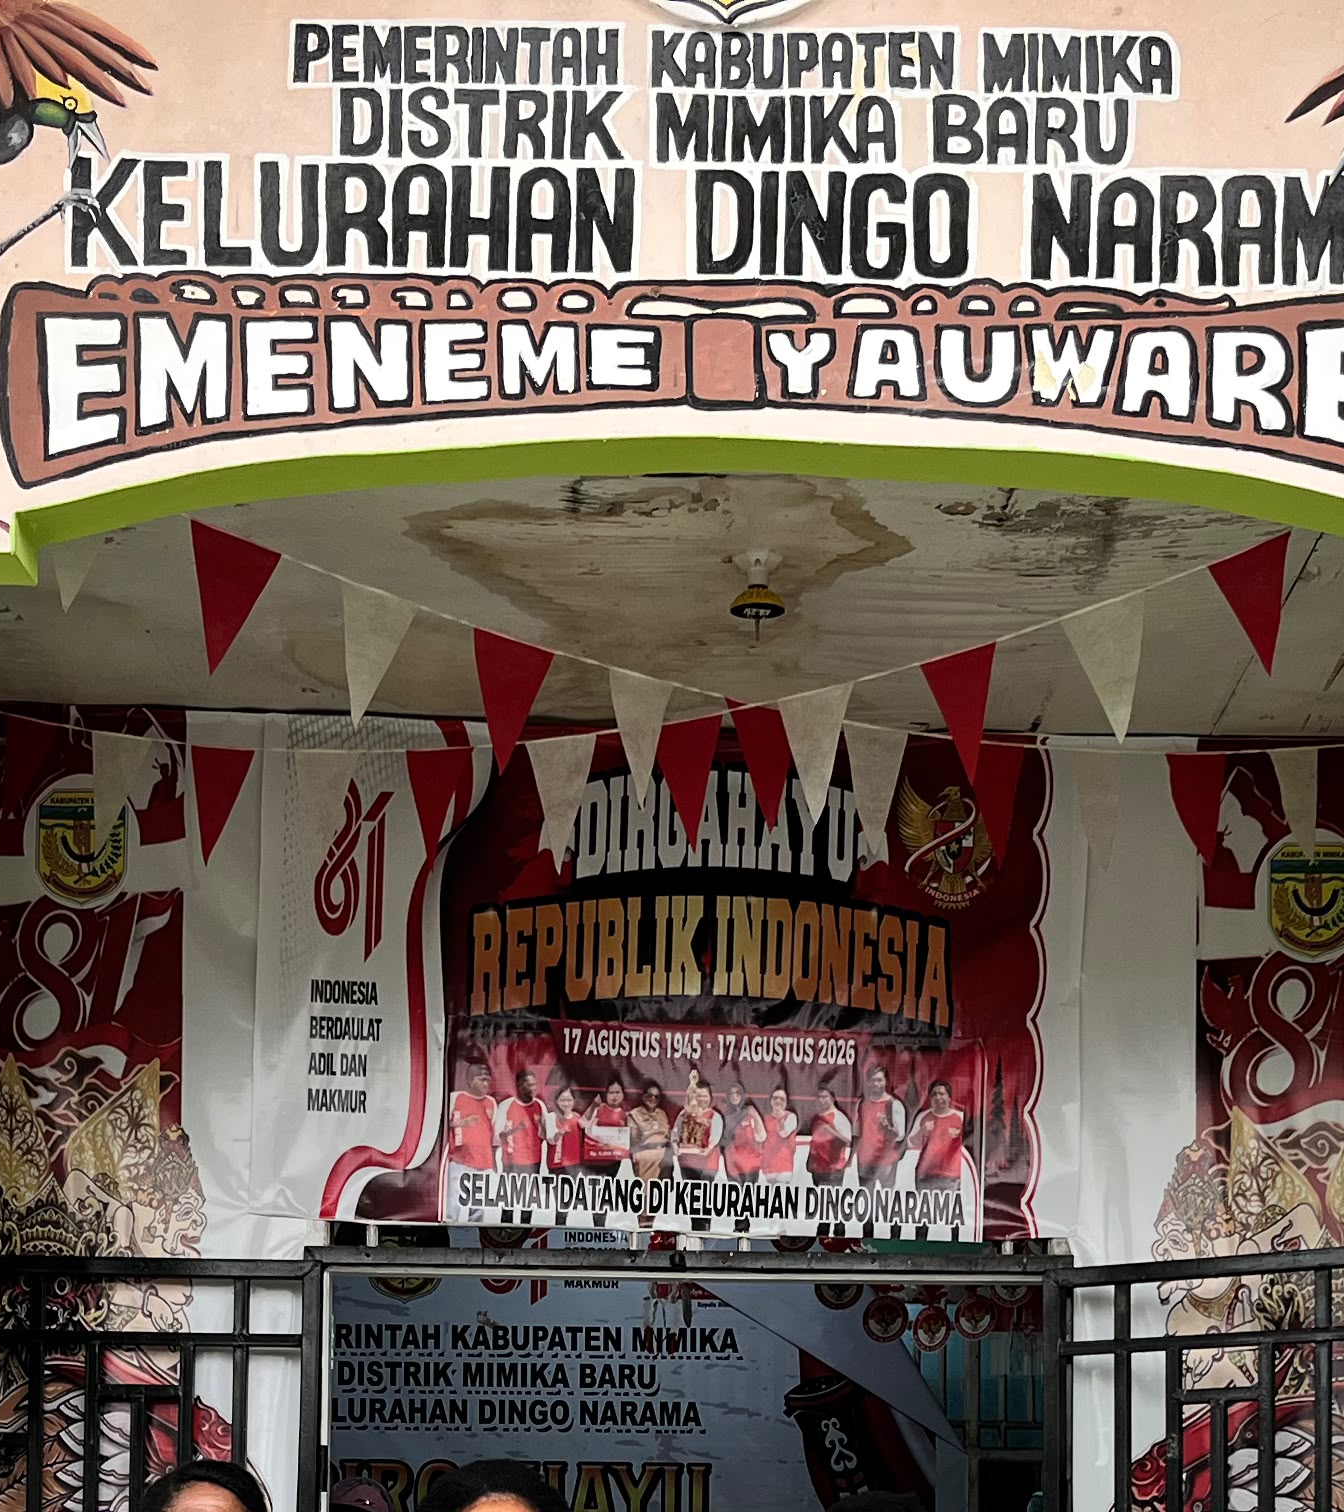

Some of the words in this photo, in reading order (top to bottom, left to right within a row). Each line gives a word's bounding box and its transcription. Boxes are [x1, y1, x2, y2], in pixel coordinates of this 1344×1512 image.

[293, 23, 619, 84] PEMERINTAH
[652, 29, 955, 91] KABUPATEN
[982, 33, 1174, 95] MIMIKA
[339, 87, 629, 158] DISTRIK
[656, 93, 896, 165] MIMIKA
[933, 97, 1130, 165] BARU
[69, 155, 636, 272] KELURAHAN
[696, 168, 969, 279] DINGO
[41, 312, 657, 461] EMENEME
[924, 886, 981, 902] INDONESIA
[470, 895, 705, 1017] REPUBLIK
[712, 895, 948, 1028] INDONESIA
[310, 978, 379, 1006] INDONESIA
[309, 1015, 383, 1042] BERDAULAT
[563, 1027, 582, 1054] 17
[585, 1029, 660, 1058] AGUSTUS
[665, 1031, 702, 1060] 1945
[717, 1034, 736, 1061] 17
[739, 1035, 815, 1065] AGUSTUS
[818, 1037, 856, 1066] 2026
[308, 1052, 337, 1077] ADIL
[340, 1053, 368, 1078] DAN
[307, 1088, 367, 1114] MAKMUR
[458, 1172, 554, 1208] SELAMAT
[560, 1176, 644, 1213] DATANG
[648, 1179, 670, 1215] DI
[674, 1180, 800, 1220] KELURAHAN
[805, 1185, 871, 1222] DINGO
[873, 1187, 966, 1226] NARAMA
[451, 1325, 623, 1352] KABUPATEN
[631, 1327, 740, 1354] MIMIKA
[337, 1361, 454, 1387] DISTRIK
[462, 1362, 571, 1388] MIMIKA
[578, 1363, 657, 1390] BARU
[478, 1399, 571, 1426] DINGO
[579, 1401, 703, 1428] NARAMA
